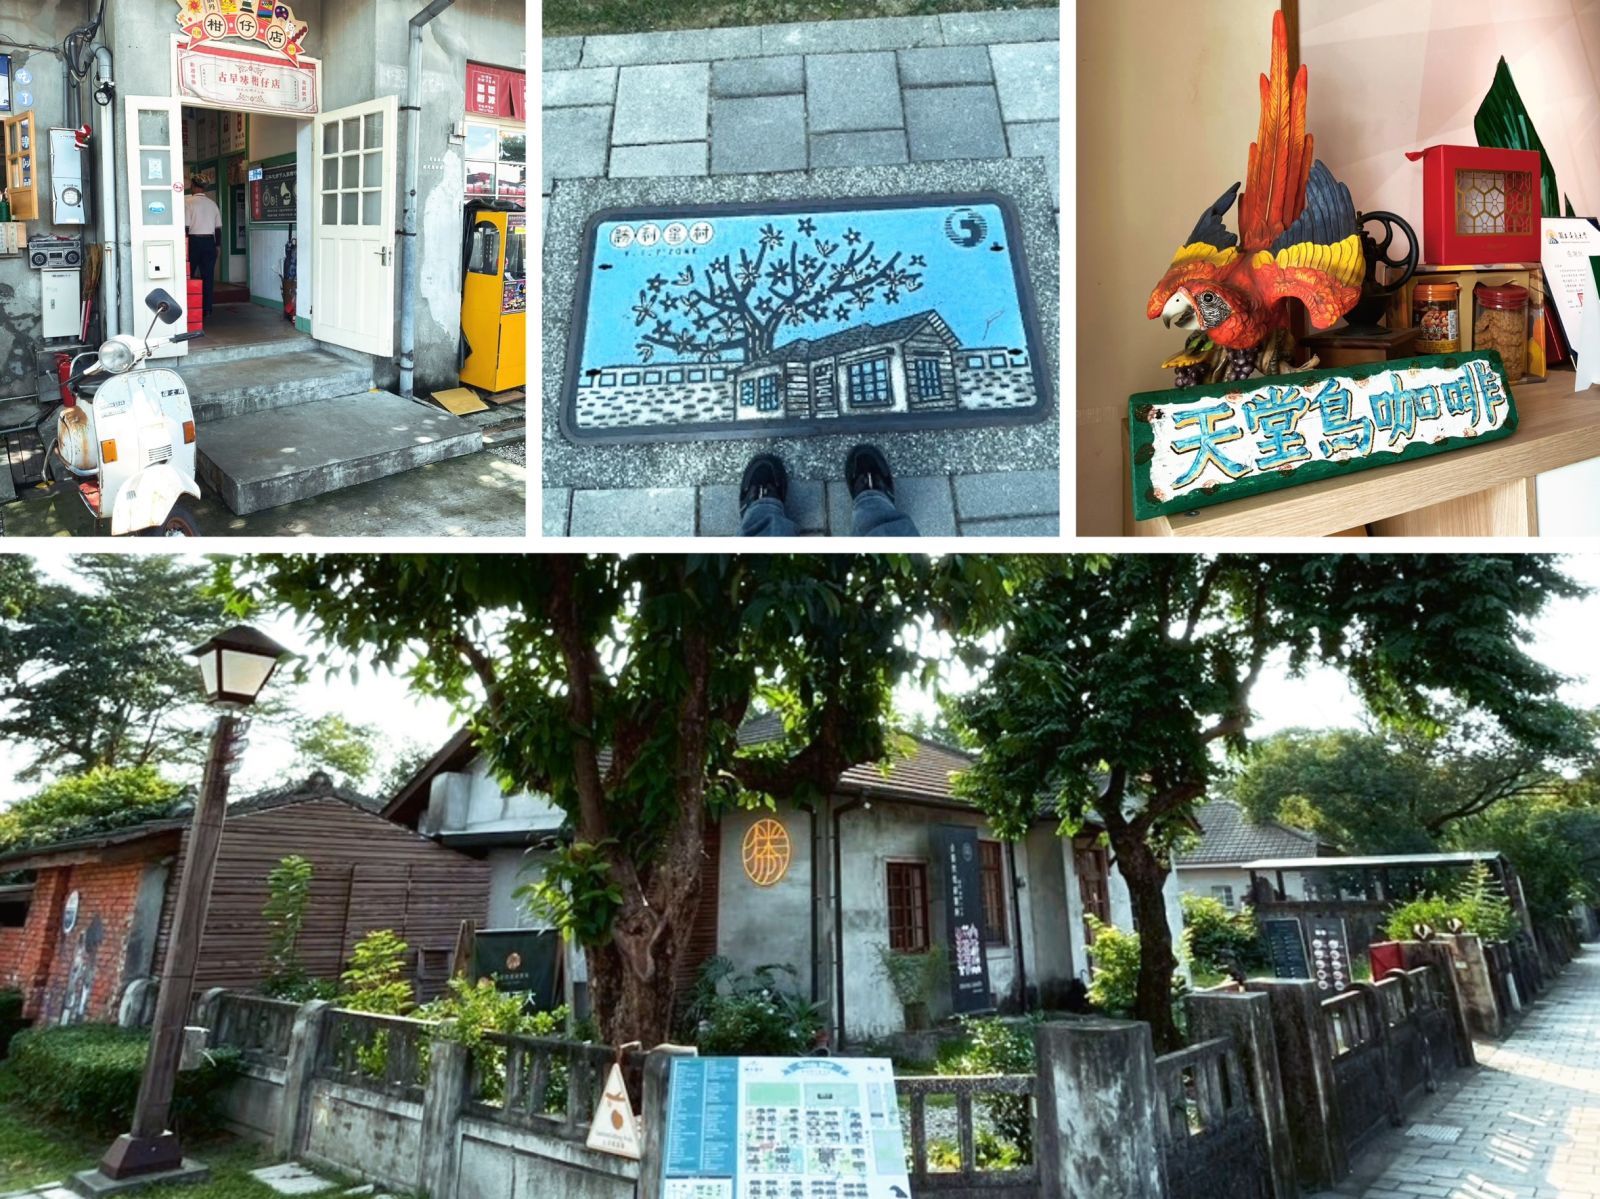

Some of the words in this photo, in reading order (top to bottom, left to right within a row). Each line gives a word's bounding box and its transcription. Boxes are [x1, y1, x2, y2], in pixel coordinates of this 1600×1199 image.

[206, 18, 284, 44] 柑仔店
[218, 71, 281, 89] 古早味柑仔店
[1171, 359, 1506, 490] 天堂鳥咖啡
